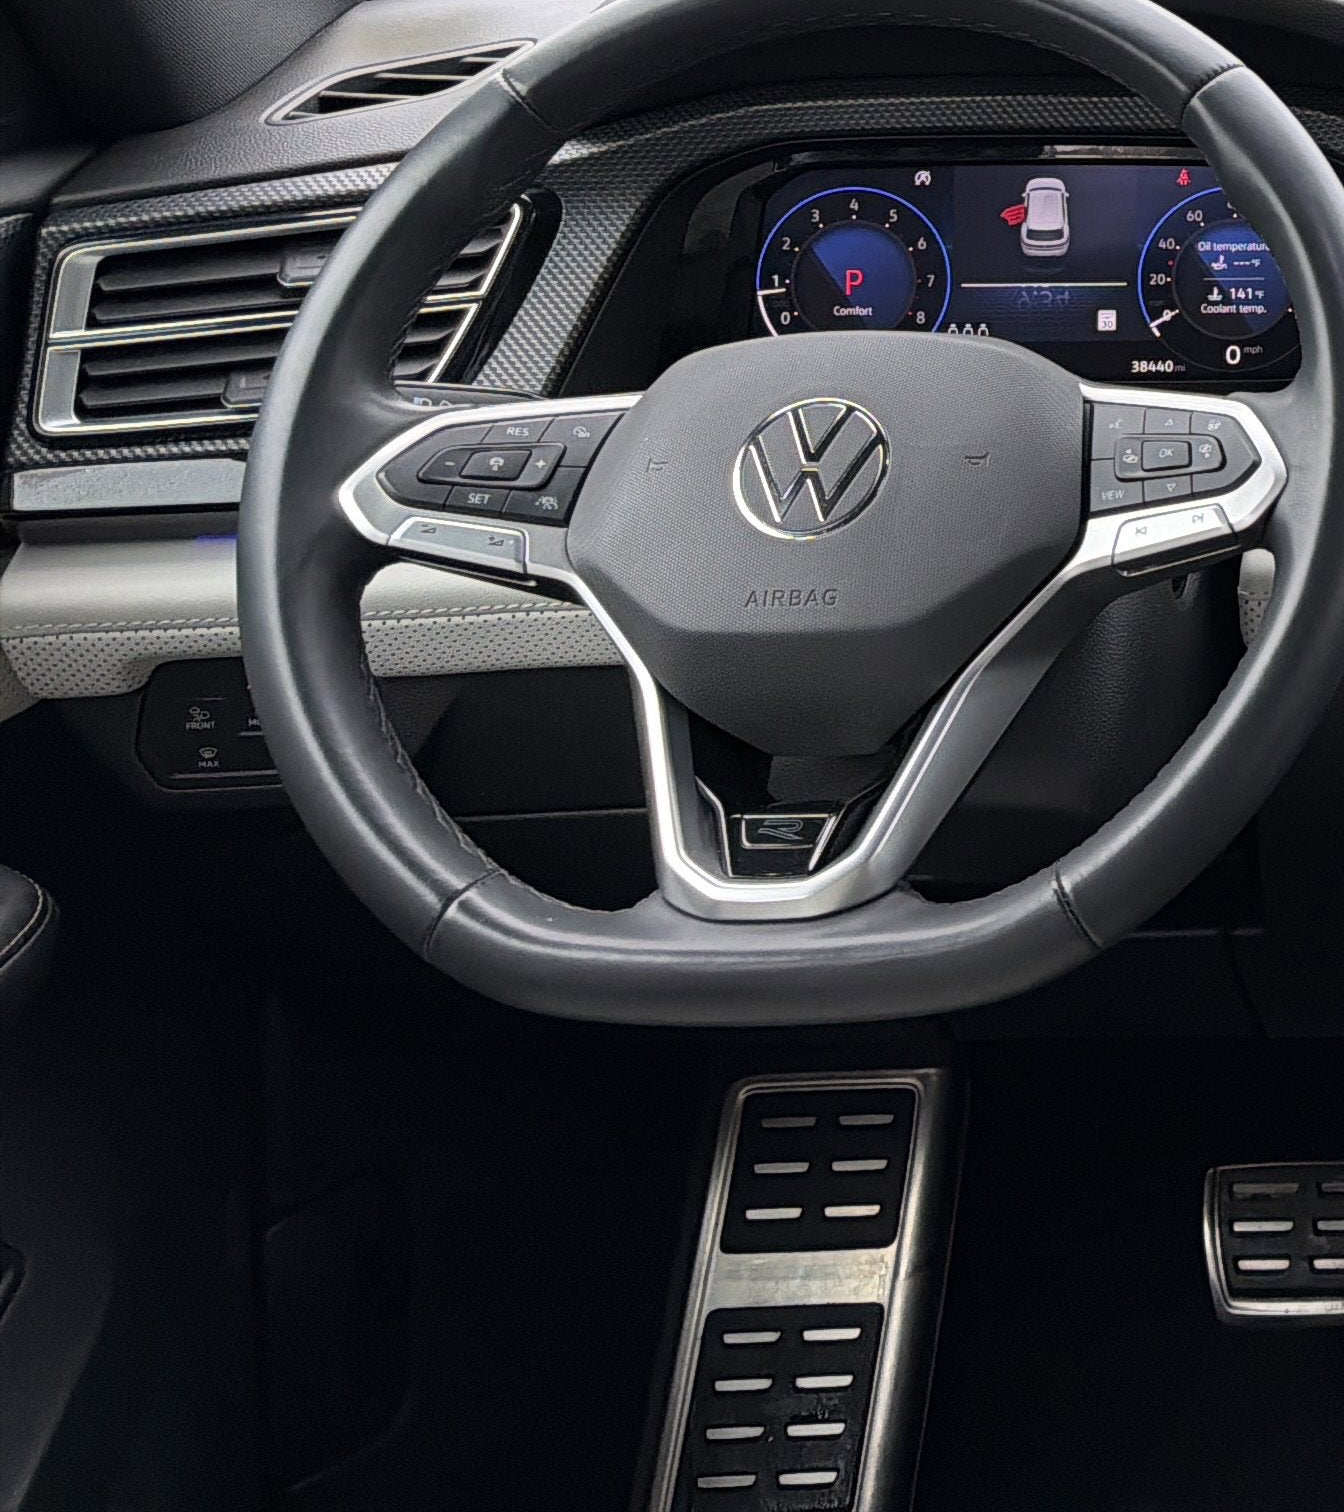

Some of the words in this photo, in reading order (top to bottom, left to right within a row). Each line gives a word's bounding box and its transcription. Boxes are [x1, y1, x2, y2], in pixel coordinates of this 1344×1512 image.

[849, 198, 859, 212] 4
[811, 209, 820, 222] 3
[889, 209, 898, 222] 5
[1186, 209, 1203, 222] 60
[781, 237, 791, 250] 2
[917, 237, 927, 250] 6
[1158, 238, 1175, 250] 40
[1197, 241, 1211, 251] Oil
[772, 274, 779, 287] 1
[845, 269, 864, 296] P
[926, 274, 935, 288] 7
[1149, 273, 1166, 286] 20
[1229, 287, 1252, 300] 141
[833, 306, 873, 316] Comfort
[1200, 303, 1237, 314] Coolant
[1238, 303, 1267, 315] temp.
[780, 312, 791, 325] 0
[916, 311, 926, 325] 8
[1101, 320, 1114, 329] 30
[1225, 345, 1241, 365] 0
[1243, 345, 1263, 355] mph
[1131, 360, 1174, 373] 38440
[1174, 363, 1186, 372] mi
[505, 426, 530, 438] RES
[1158, 447, 1175, 458] OK
[466, 493, 492, 505] SET
[1101, 489, 1126, 501] VIEW
[743, 588, 840, 608] AIRBAG
[185, 720, 216, 730] FRONT
[198, 760, 220, 768] MAX
